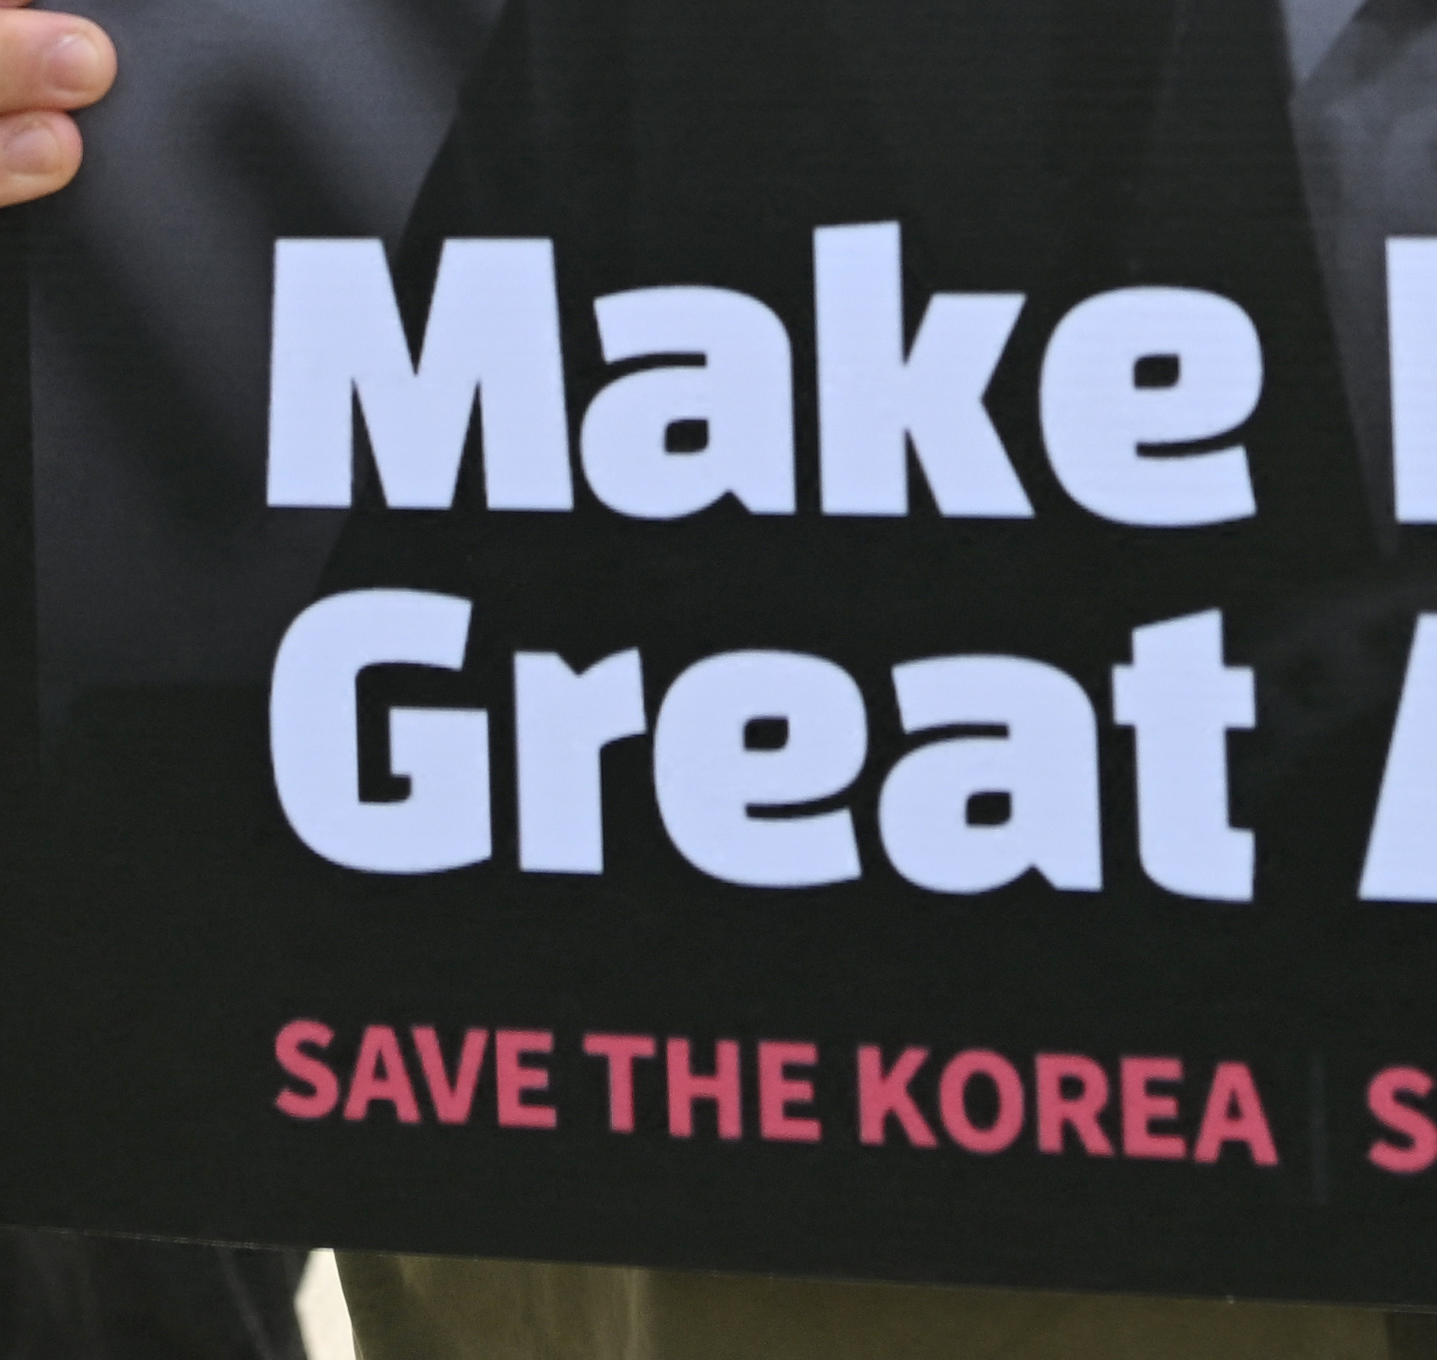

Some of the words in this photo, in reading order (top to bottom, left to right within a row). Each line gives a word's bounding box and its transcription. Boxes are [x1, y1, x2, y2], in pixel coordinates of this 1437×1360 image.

[267, 221, 1263, 526] Make
[269, 588, 1256, 902] Great
[274, 1019, 557, 1128] SAVE
[582, 1033, 822, 1142] THE
[857, 1045, 1279, 1166] KOREA
